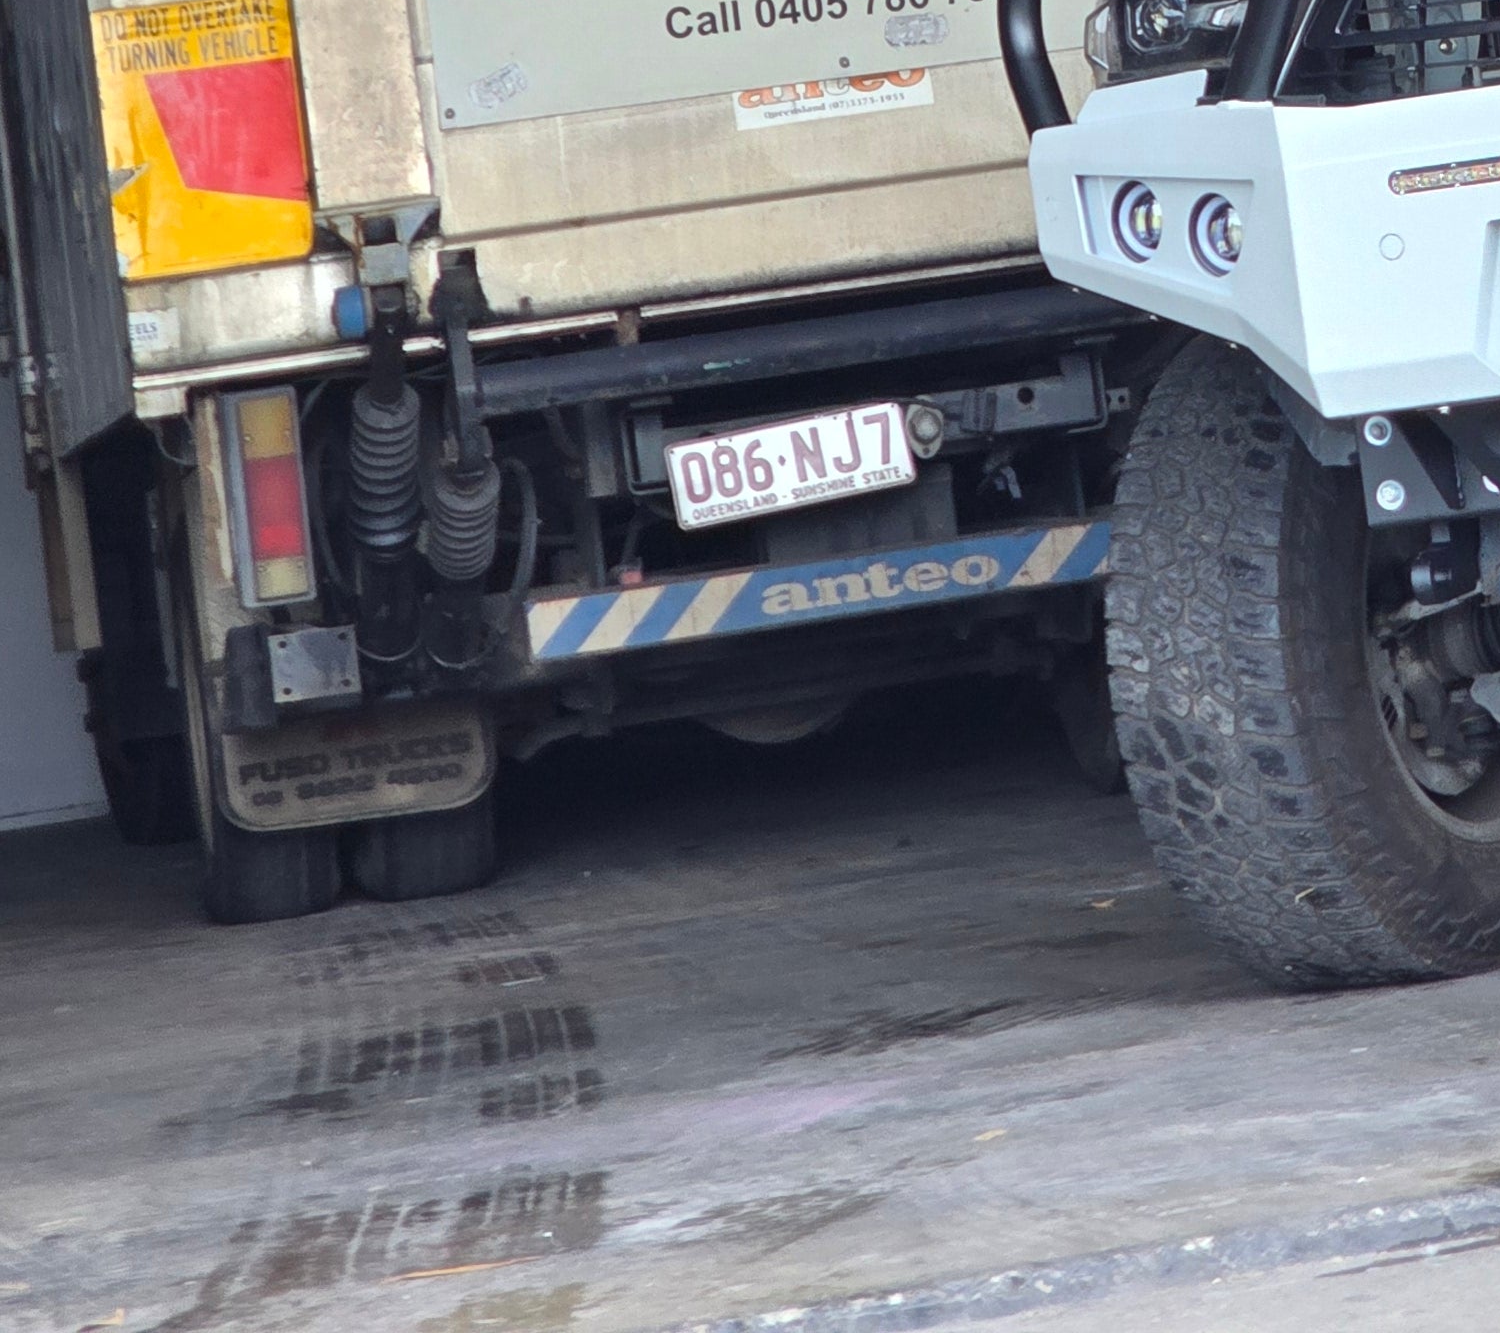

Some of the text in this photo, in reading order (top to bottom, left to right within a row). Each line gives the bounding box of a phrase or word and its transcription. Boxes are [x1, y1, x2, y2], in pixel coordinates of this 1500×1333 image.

[101, 14, 127, 41] DO
[133, 6, 170, 36] NOT
[665, 0, 741, 39] Call
[106, 26, 279, 73] TURNING VEHICLE
[692, 492, 779, 521] QUEENSLAND
[791, 475, 856, 500] SUNSHINE
[862, 465, 902, 484] STATE
[759, 552, 1000, 617] anteo
